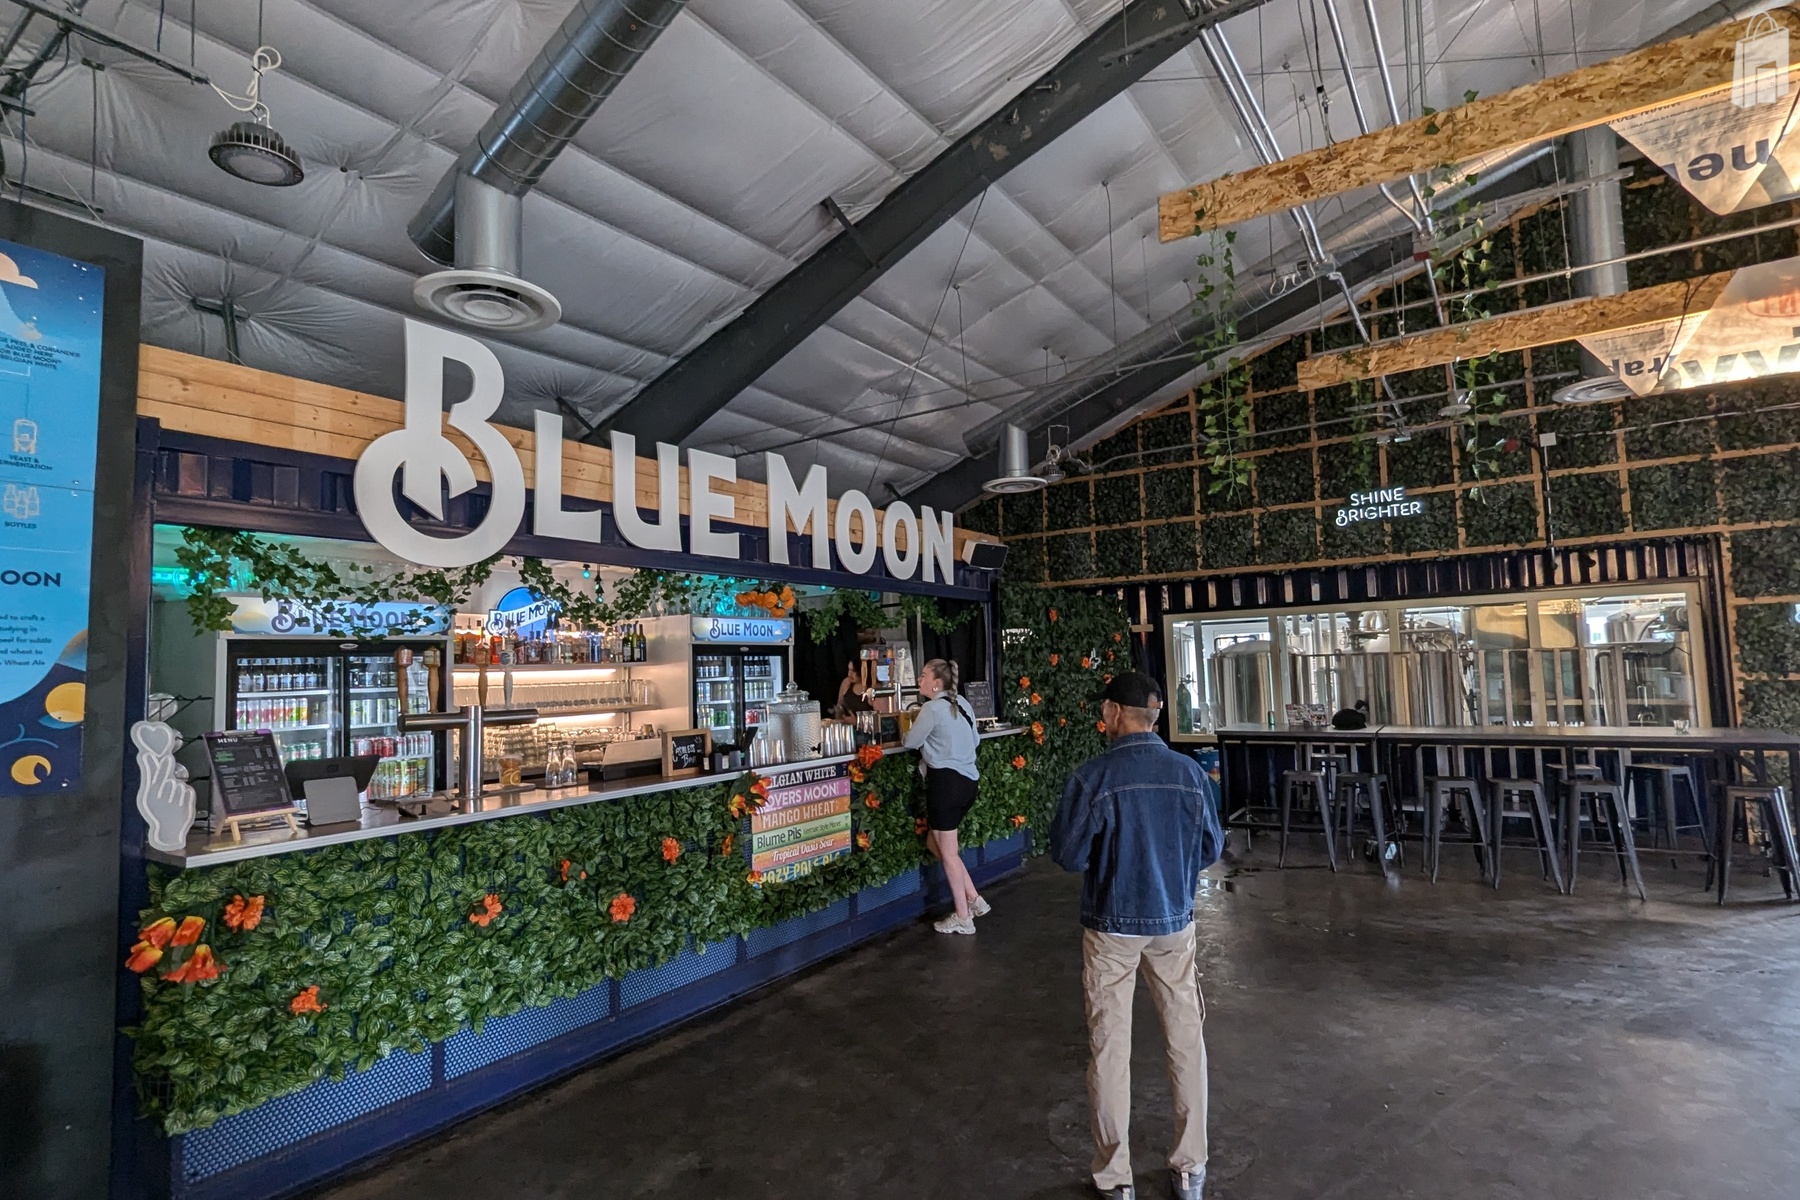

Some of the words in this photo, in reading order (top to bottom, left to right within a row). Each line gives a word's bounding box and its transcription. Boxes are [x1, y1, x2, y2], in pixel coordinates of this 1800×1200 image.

[5, 343, 32, 353] ADDED
[34, 350, 54, 358] HERE
[13, 350, 31, 359] BLUE
[37, 344, 80, 358] CORIANDER
[34, 361, 57, 371] WHITE
[9, 455, 31, 463] YEAST
[354, 317, 740, 567] BLUE
[765, 451, 954, 586] MOON
[1350, 487, 1404, 506] SHINE
[1335, 501, 1421, 526] BRIGHTER
[5, 521, 37, 530] BOTTLES
[0, 569, 61, 588] OON
[271, 601, 343, 633] BLUE
[490, 611, 526, 631] BLUE
[710, 619, 740, 638] BLUE
[744, 622, 773, 637] MOON
[804, 766, 836, 783] WHITE
[765, 790, 801, 808] OVERS
[803, 783, 837, 802] MOON
[762, 808, 800, 829] MANGO
[803, 800, 835, 820] WHEAT
[757, 832, 785, 849] Blume
[788, 827, 802, 841] Pils
[772, 847, 800, 863] Tropical
[801, 842, 819, 855] Oasis
[820, 838, 834, 849] Sour
